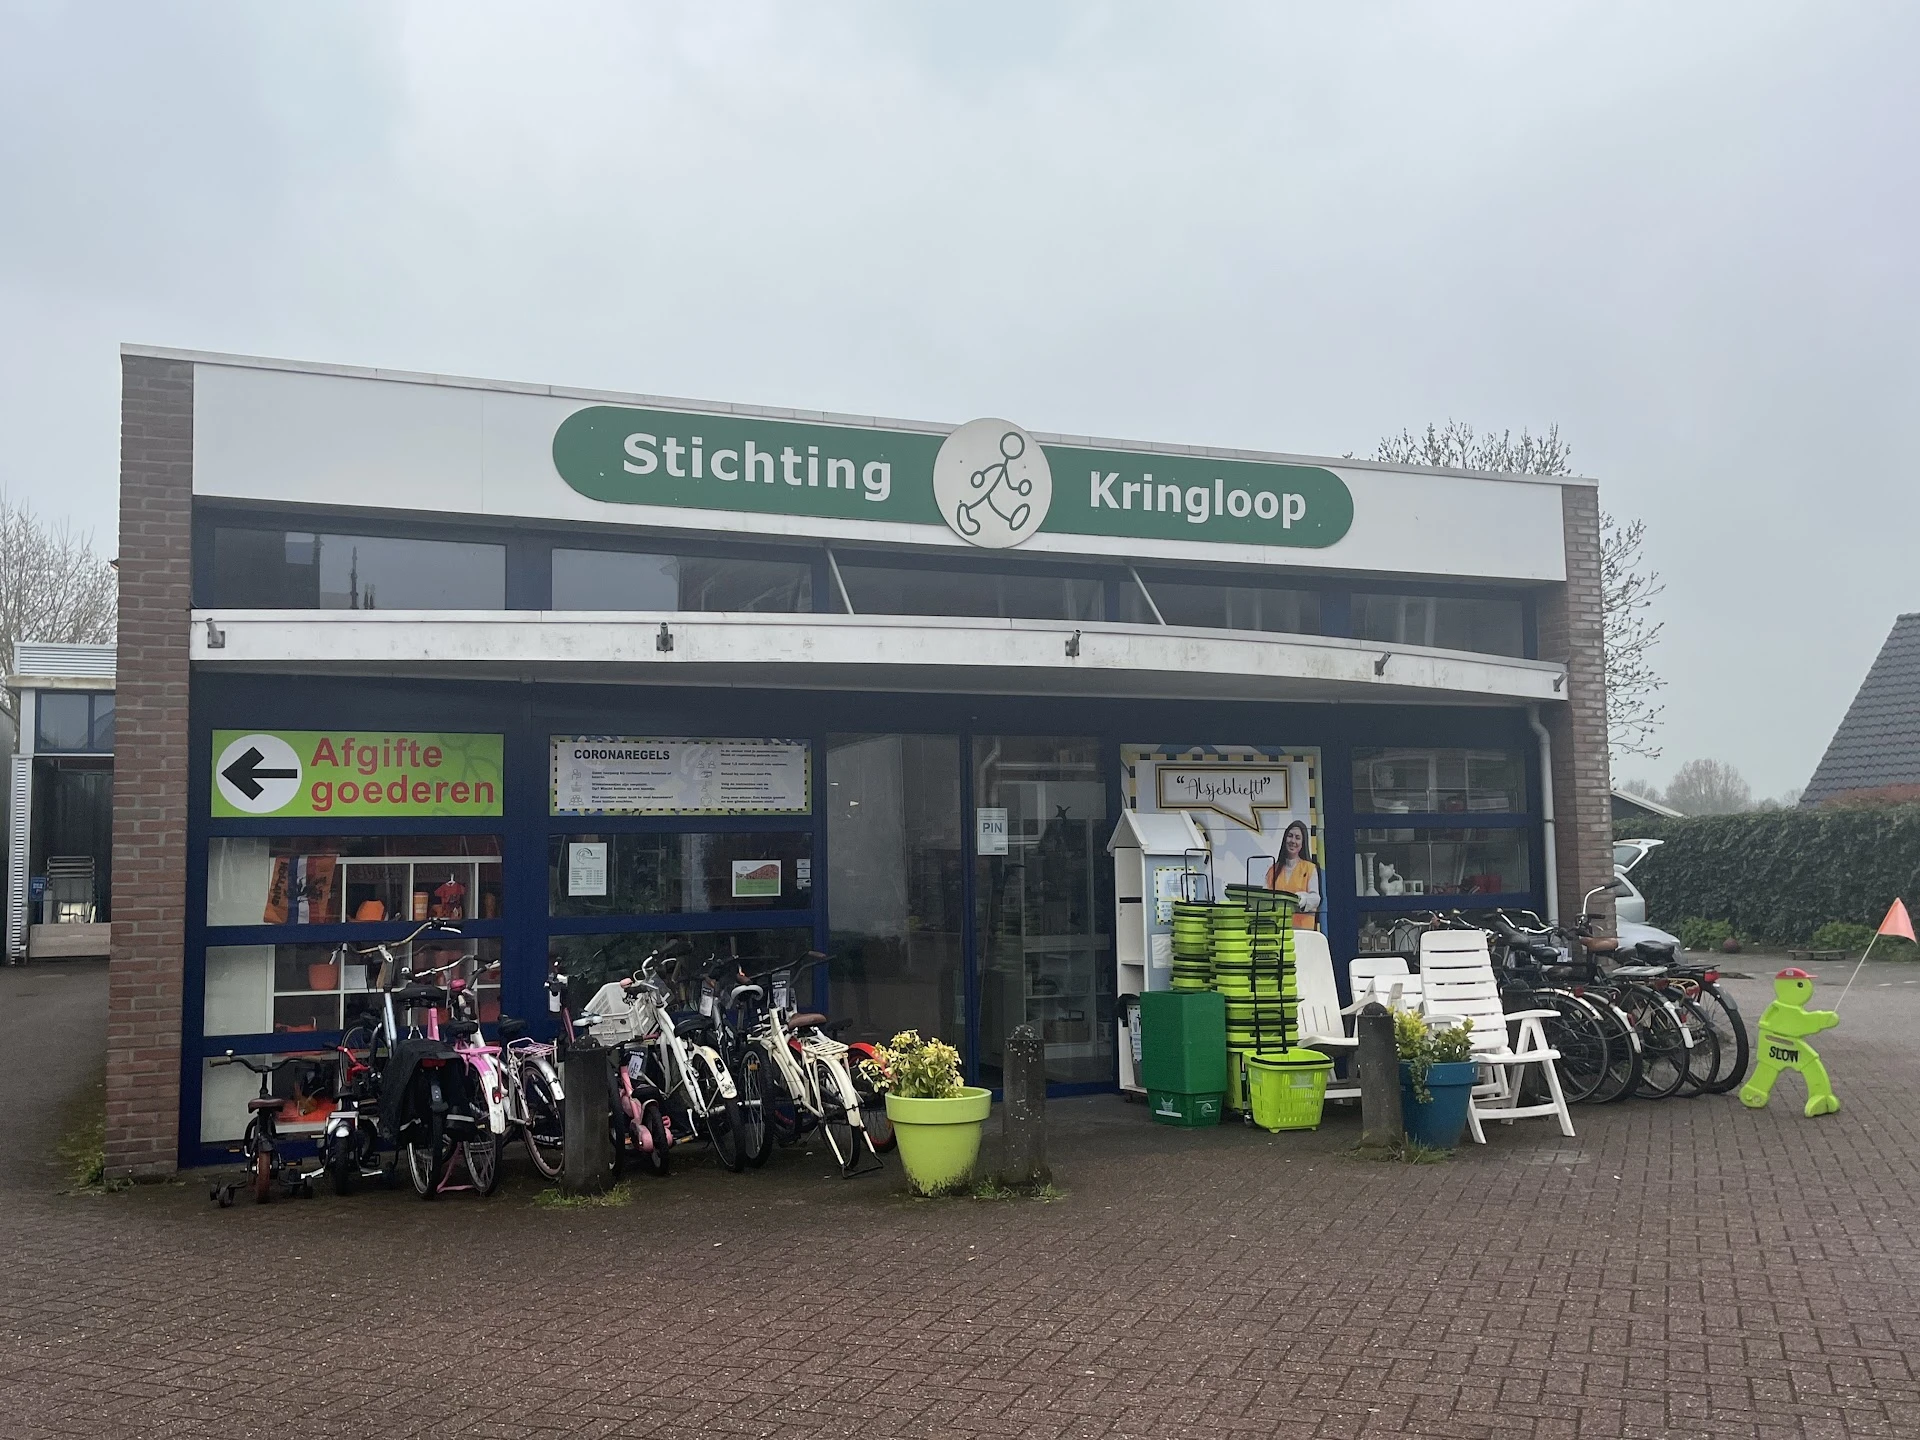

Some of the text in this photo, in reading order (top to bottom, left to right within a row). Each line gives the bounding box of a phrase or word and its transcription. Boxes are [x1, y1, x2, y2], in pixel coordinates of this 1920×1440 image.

[622, 433, 1308, 529] Stichting Kringloop
[310, 737, 443, 775] Afgifte
[574, 749, 670, 760] CORONAREGELS
[311, 775, 494, 812] goederen
[982, 822, 1003, 834] PIN
[1769, 1046, 1799, 1062] SLOW
